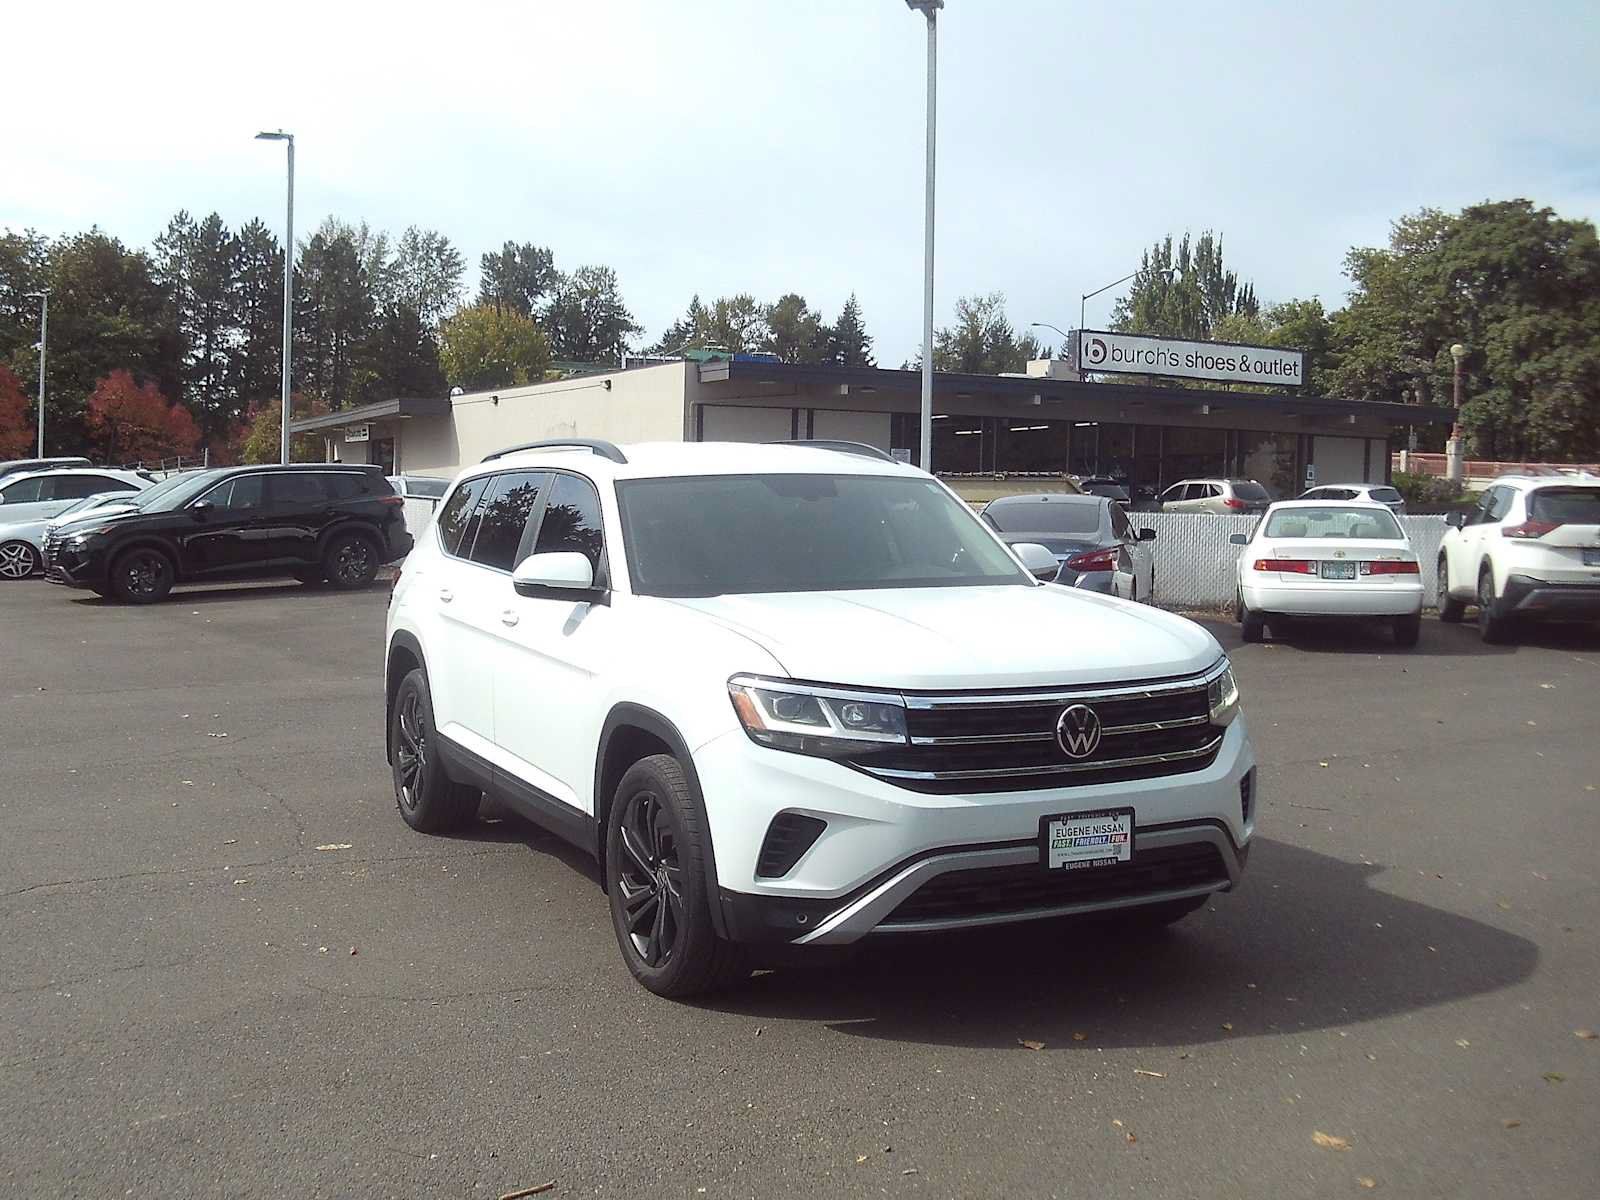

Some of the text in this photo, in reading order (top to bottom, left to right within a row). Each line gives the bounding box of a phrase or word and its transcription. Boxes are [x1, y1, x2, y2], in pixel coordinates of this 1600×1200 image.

[1111, 343, 1299, 377] burch's shoes & outlet
[1056, 823, 1124, 838] EUGENE NISSAN
[1065, 858, 1117, 870] EUGENE NISSAN
